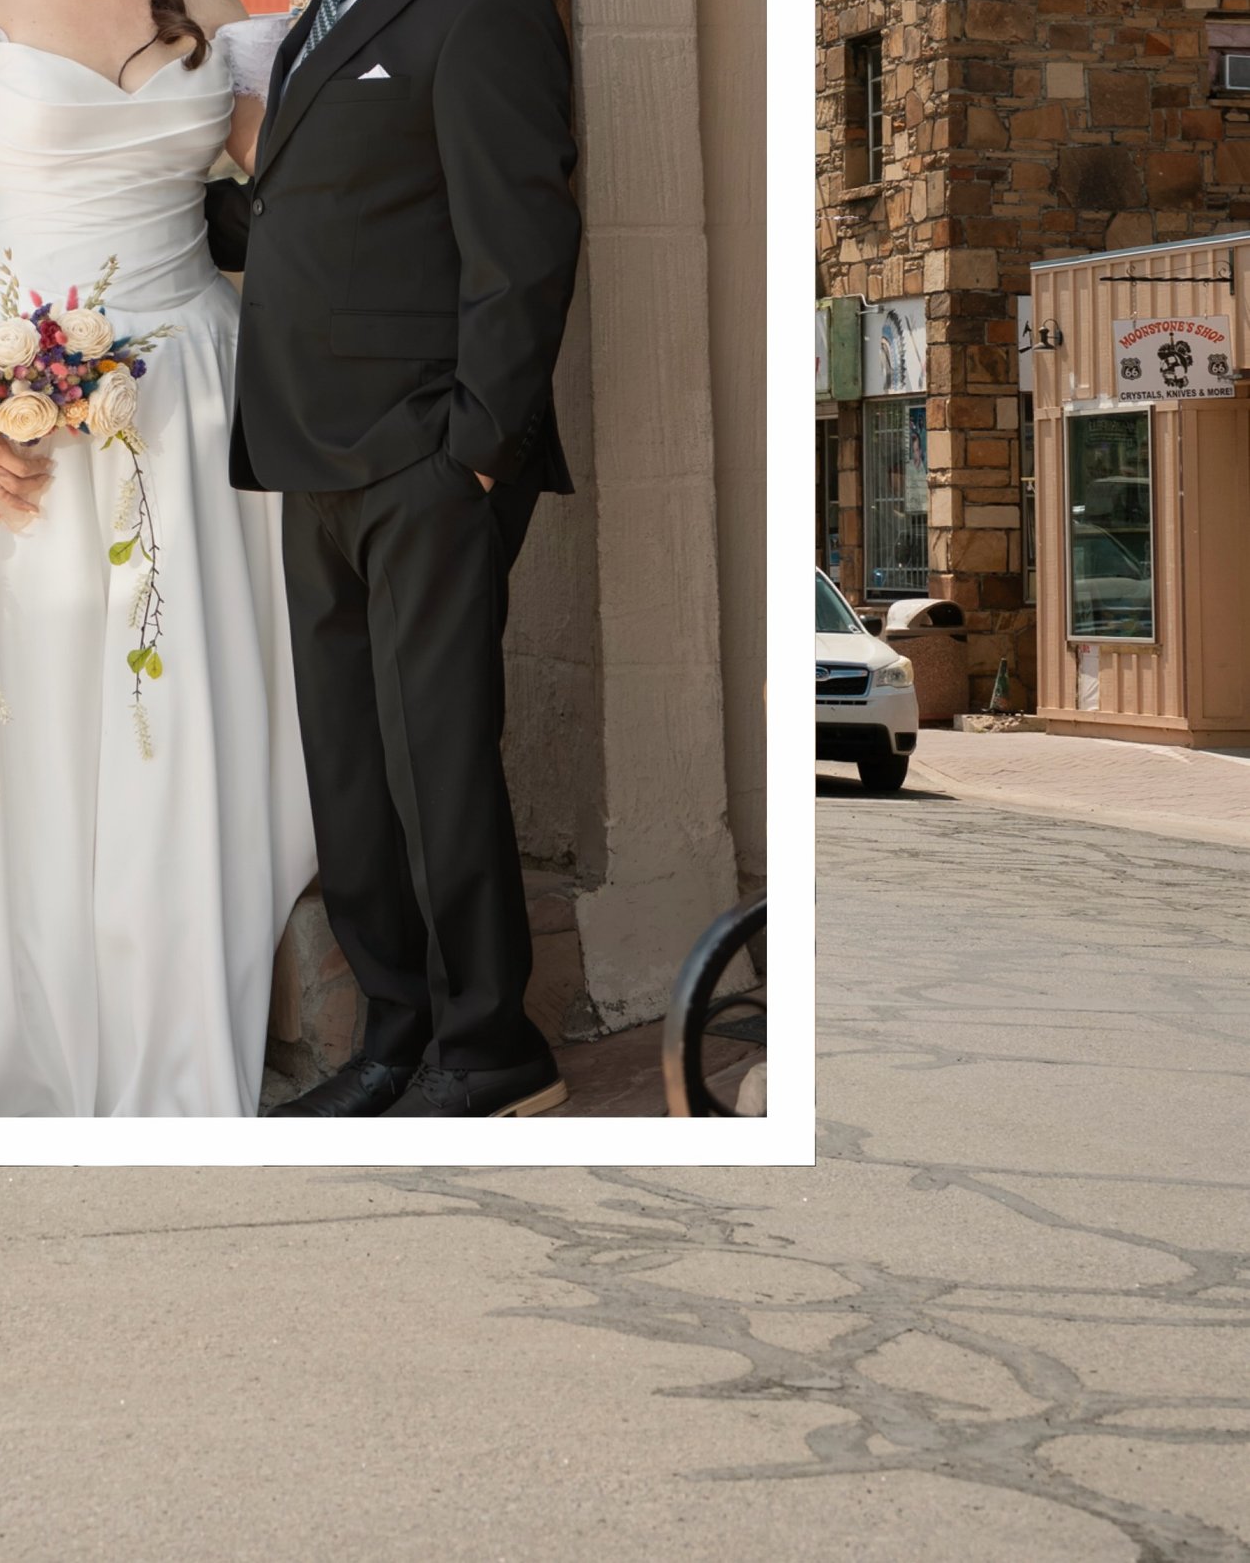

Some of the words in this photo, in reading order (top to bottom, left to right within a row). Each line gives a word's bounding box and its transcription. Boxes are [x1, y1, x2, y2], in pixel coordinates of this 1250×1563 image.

[1119, 320, 1194, 349] MOONSTONE'S
[1194, 324, 1225, 343] SHOP
[1125, 366, 1138, 376] 66
[1211, 363, 1225, 373] 66
[1120, 390, 1164, 400] CRYSTALS,
[1166, 389, 1197, 398] KNIVES
[1199, 388, 1205, 397] &
[1207, 387, 1233, 396] MORE!
